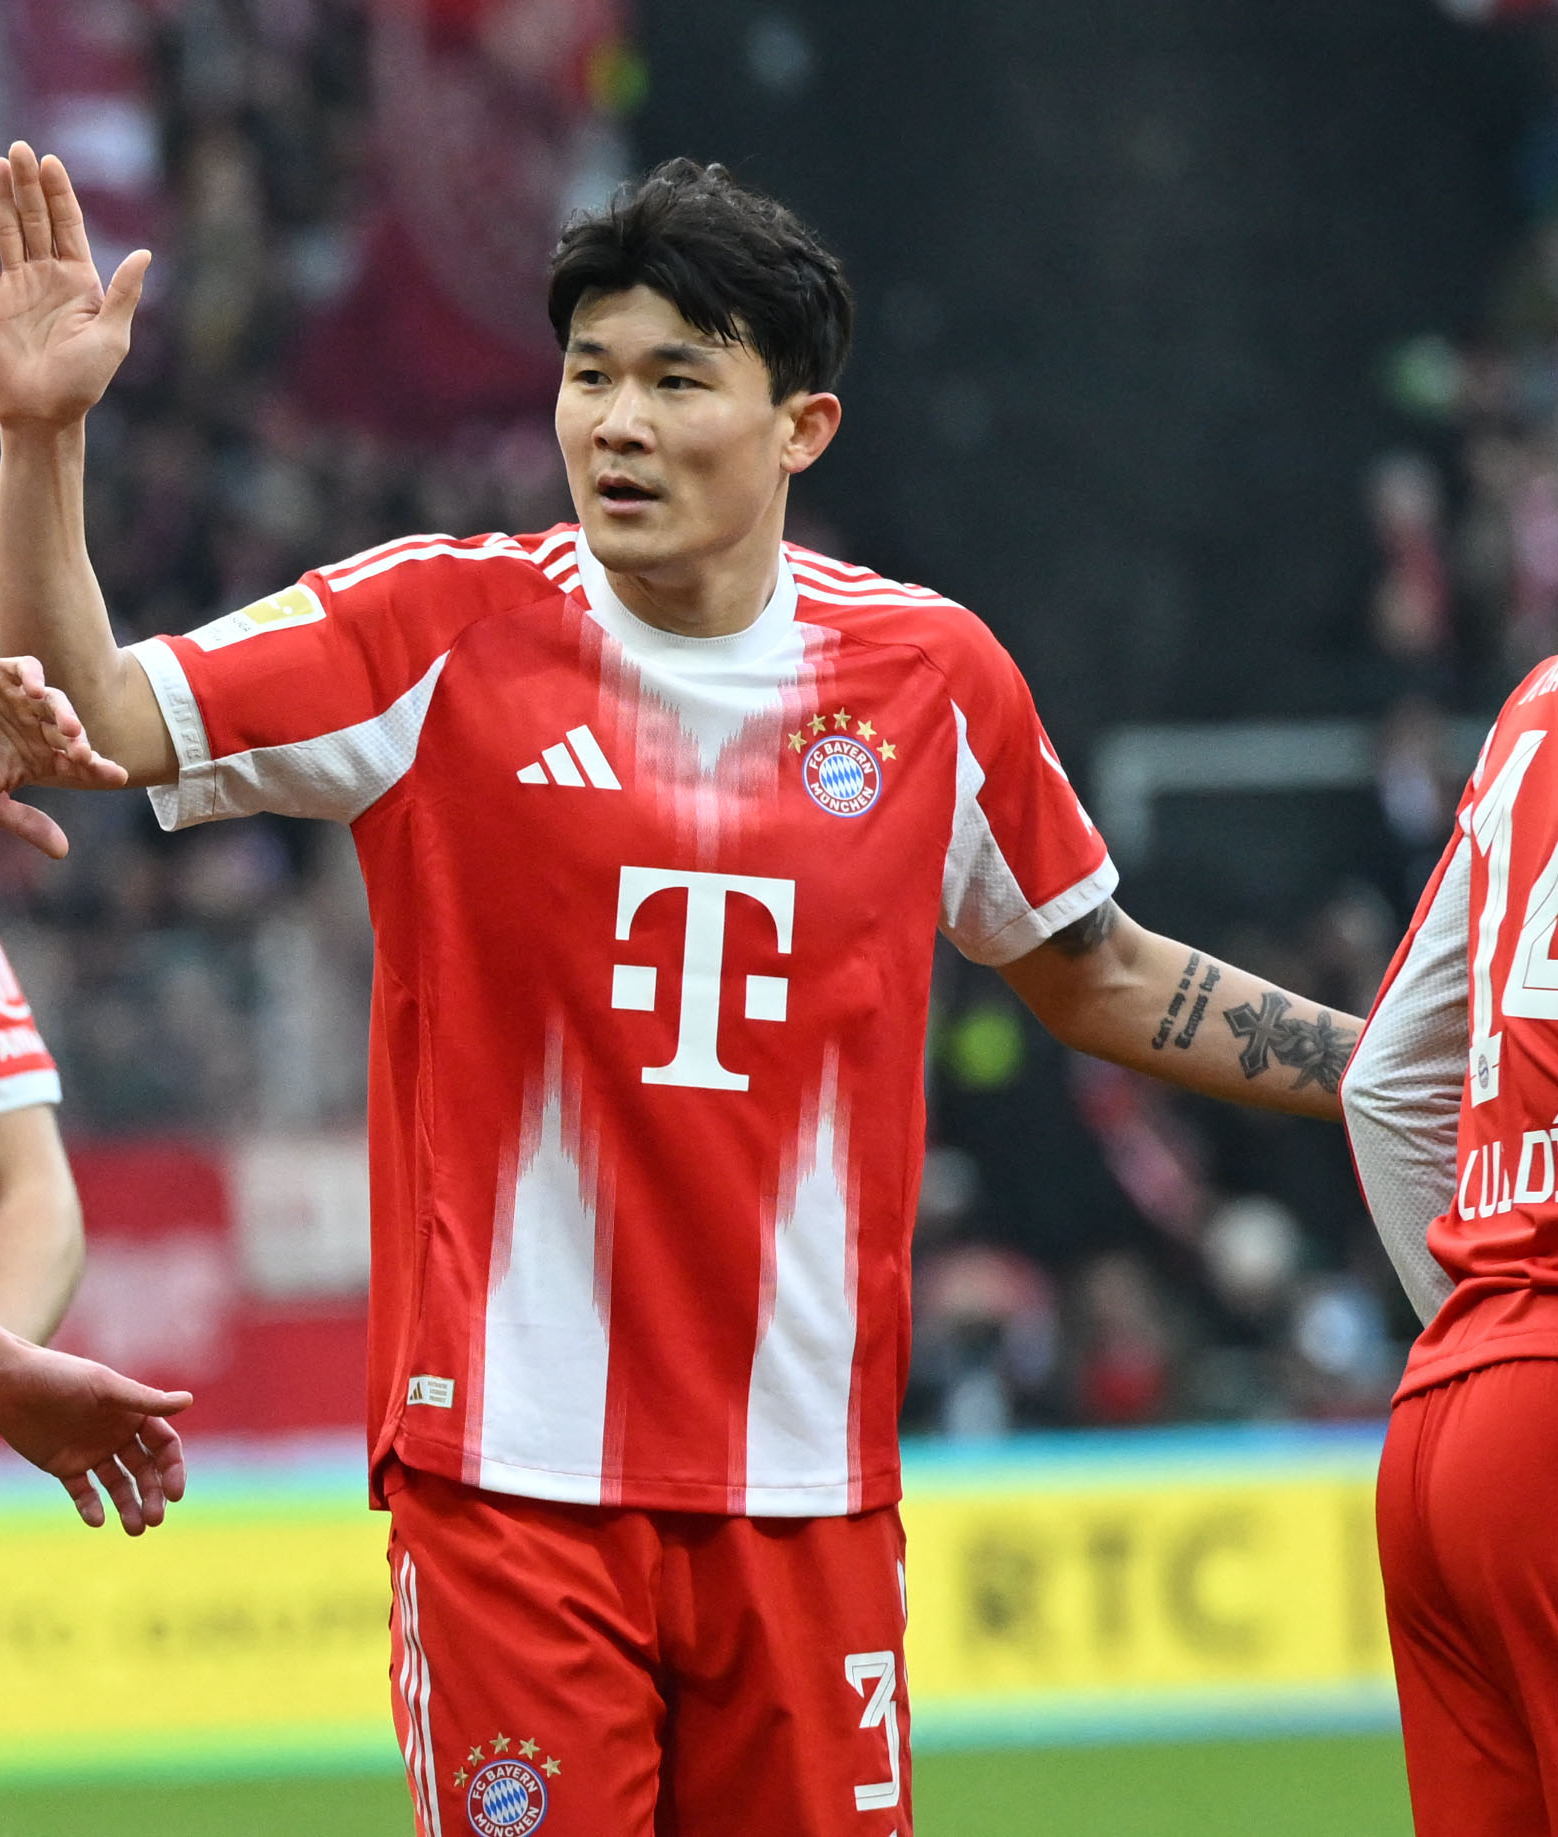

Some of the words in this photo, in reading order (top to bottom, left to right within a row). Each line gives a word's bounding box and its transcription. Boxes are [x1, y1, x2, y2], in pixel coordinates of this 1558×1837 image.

[808, 750, 824, 770] FC
[823, 741, 874, 774] BAYERN
[810, 782, 874, 813] MÜNCHEN
[611, 865, 796, 1092] T
[845, 1650, 901, 1812] 3
[472, 1780, 486, 1800] FC
[485, 1765, 538, 1793] BAYERN
[474, 1806, 540, 1837] MÜNCHEN
